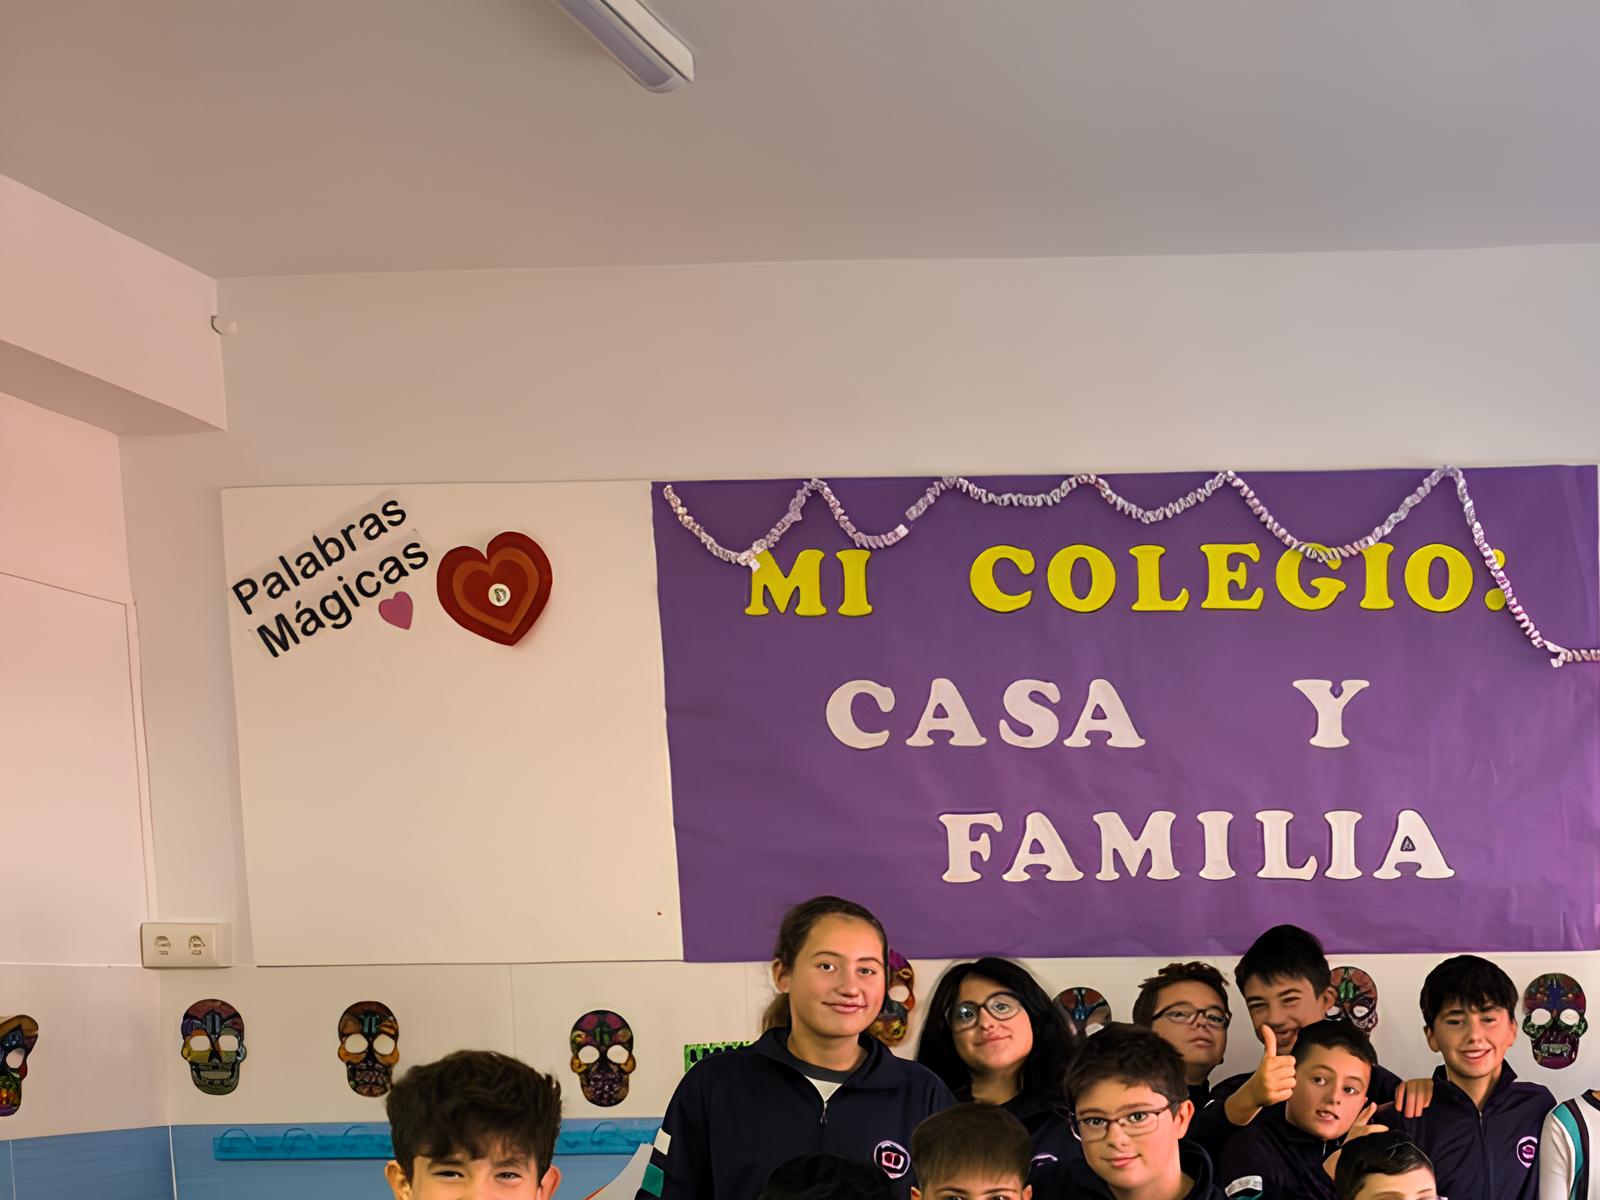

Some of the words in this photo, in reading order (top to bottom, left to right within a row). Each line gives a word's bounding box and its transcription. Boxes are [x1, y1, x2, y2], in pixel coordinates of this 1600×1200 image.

[231, 500, 407, 615] Palabras
[744, 548, 874, 617] MI
[969, 543, 1506, 613] COLEGIO:
[256, 542, 429, 658] Mágicas
[825, 678, 1146, 750] CASA
[1292, 678, 1370, 749] Y
[940, 809, 1456, 883] FAMILIA
